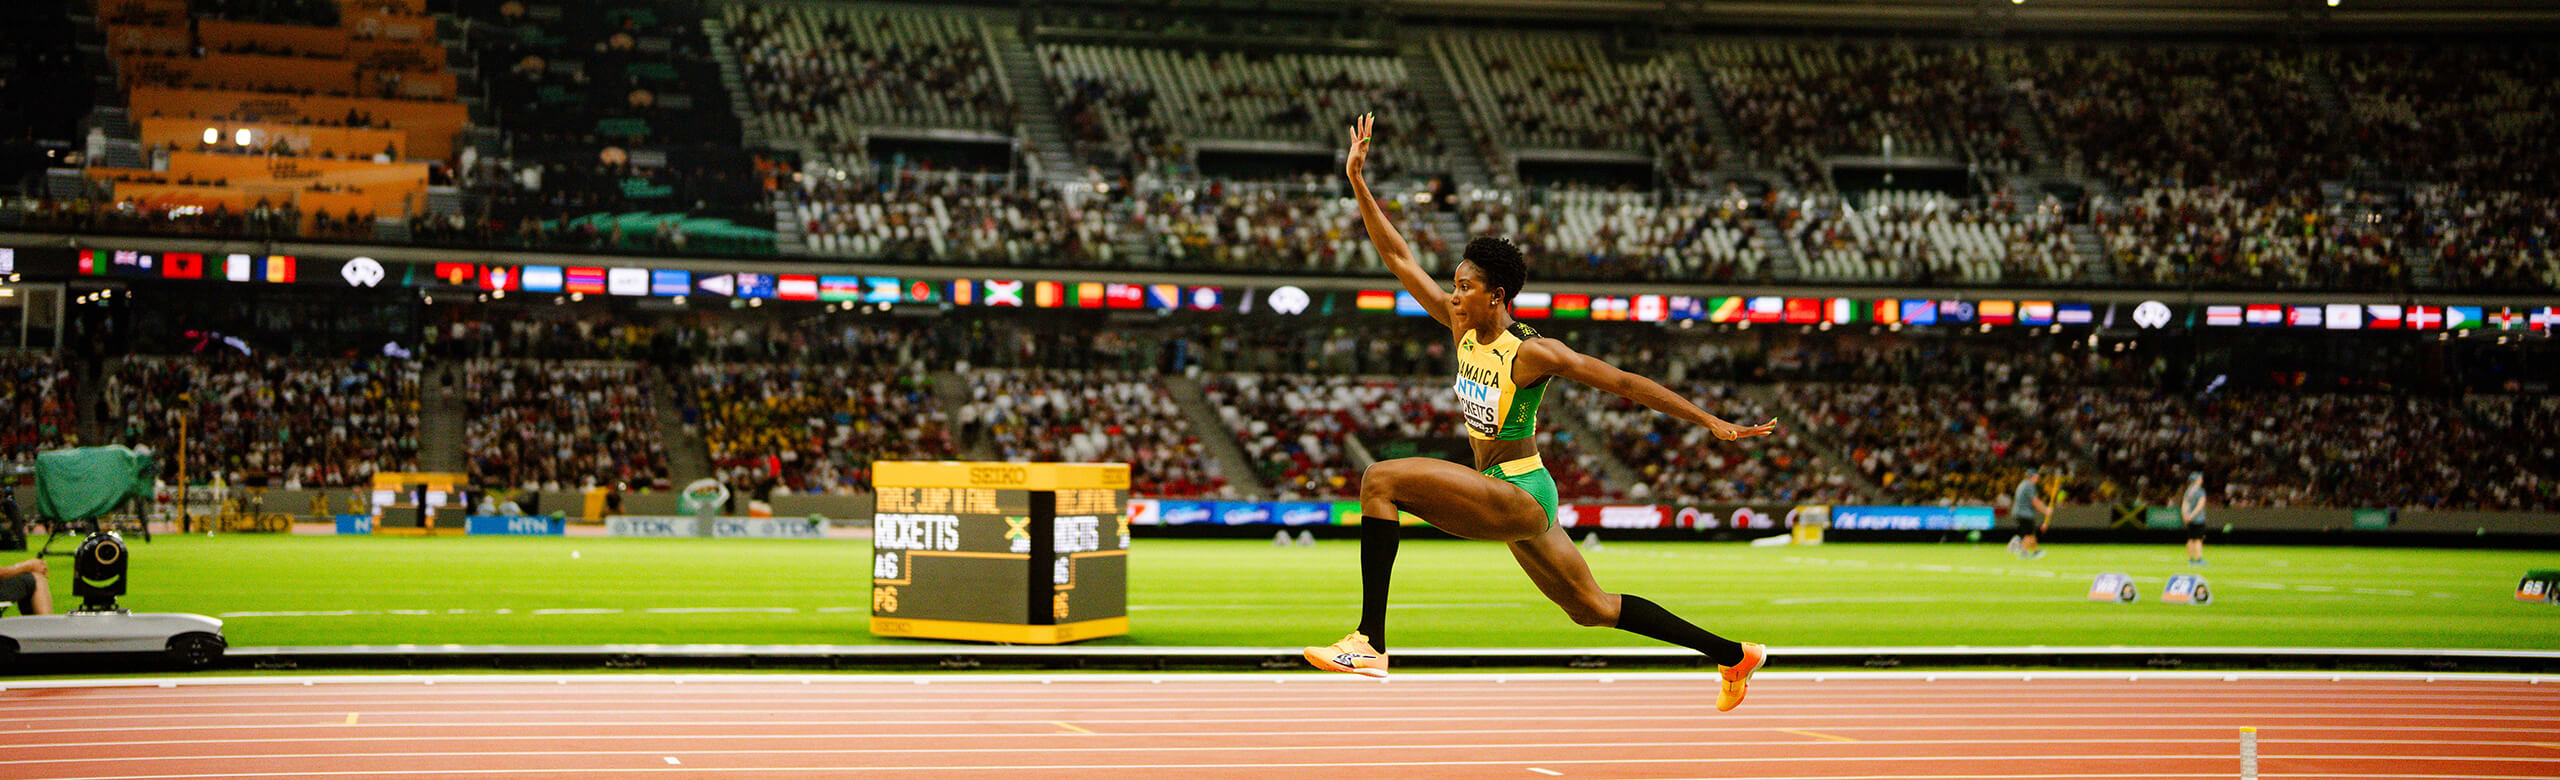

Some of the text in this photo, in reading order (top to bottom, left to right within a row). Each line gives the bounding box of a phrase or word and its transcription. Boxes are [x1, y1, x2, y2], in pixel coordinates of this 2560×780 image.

[1458, 360, 1499, 388] AMAICA
[1458, 377, 1487, 402] NTN
[970, 467, 1027, 484] SEIKO
[917, 487, 950, 513] JP
[508, 519, 549, 532] NTN
[630, 521, 673, 534] TDK
[716, 522, 748, 534] DK
[874, 513, 959, 550] RICKETTS
